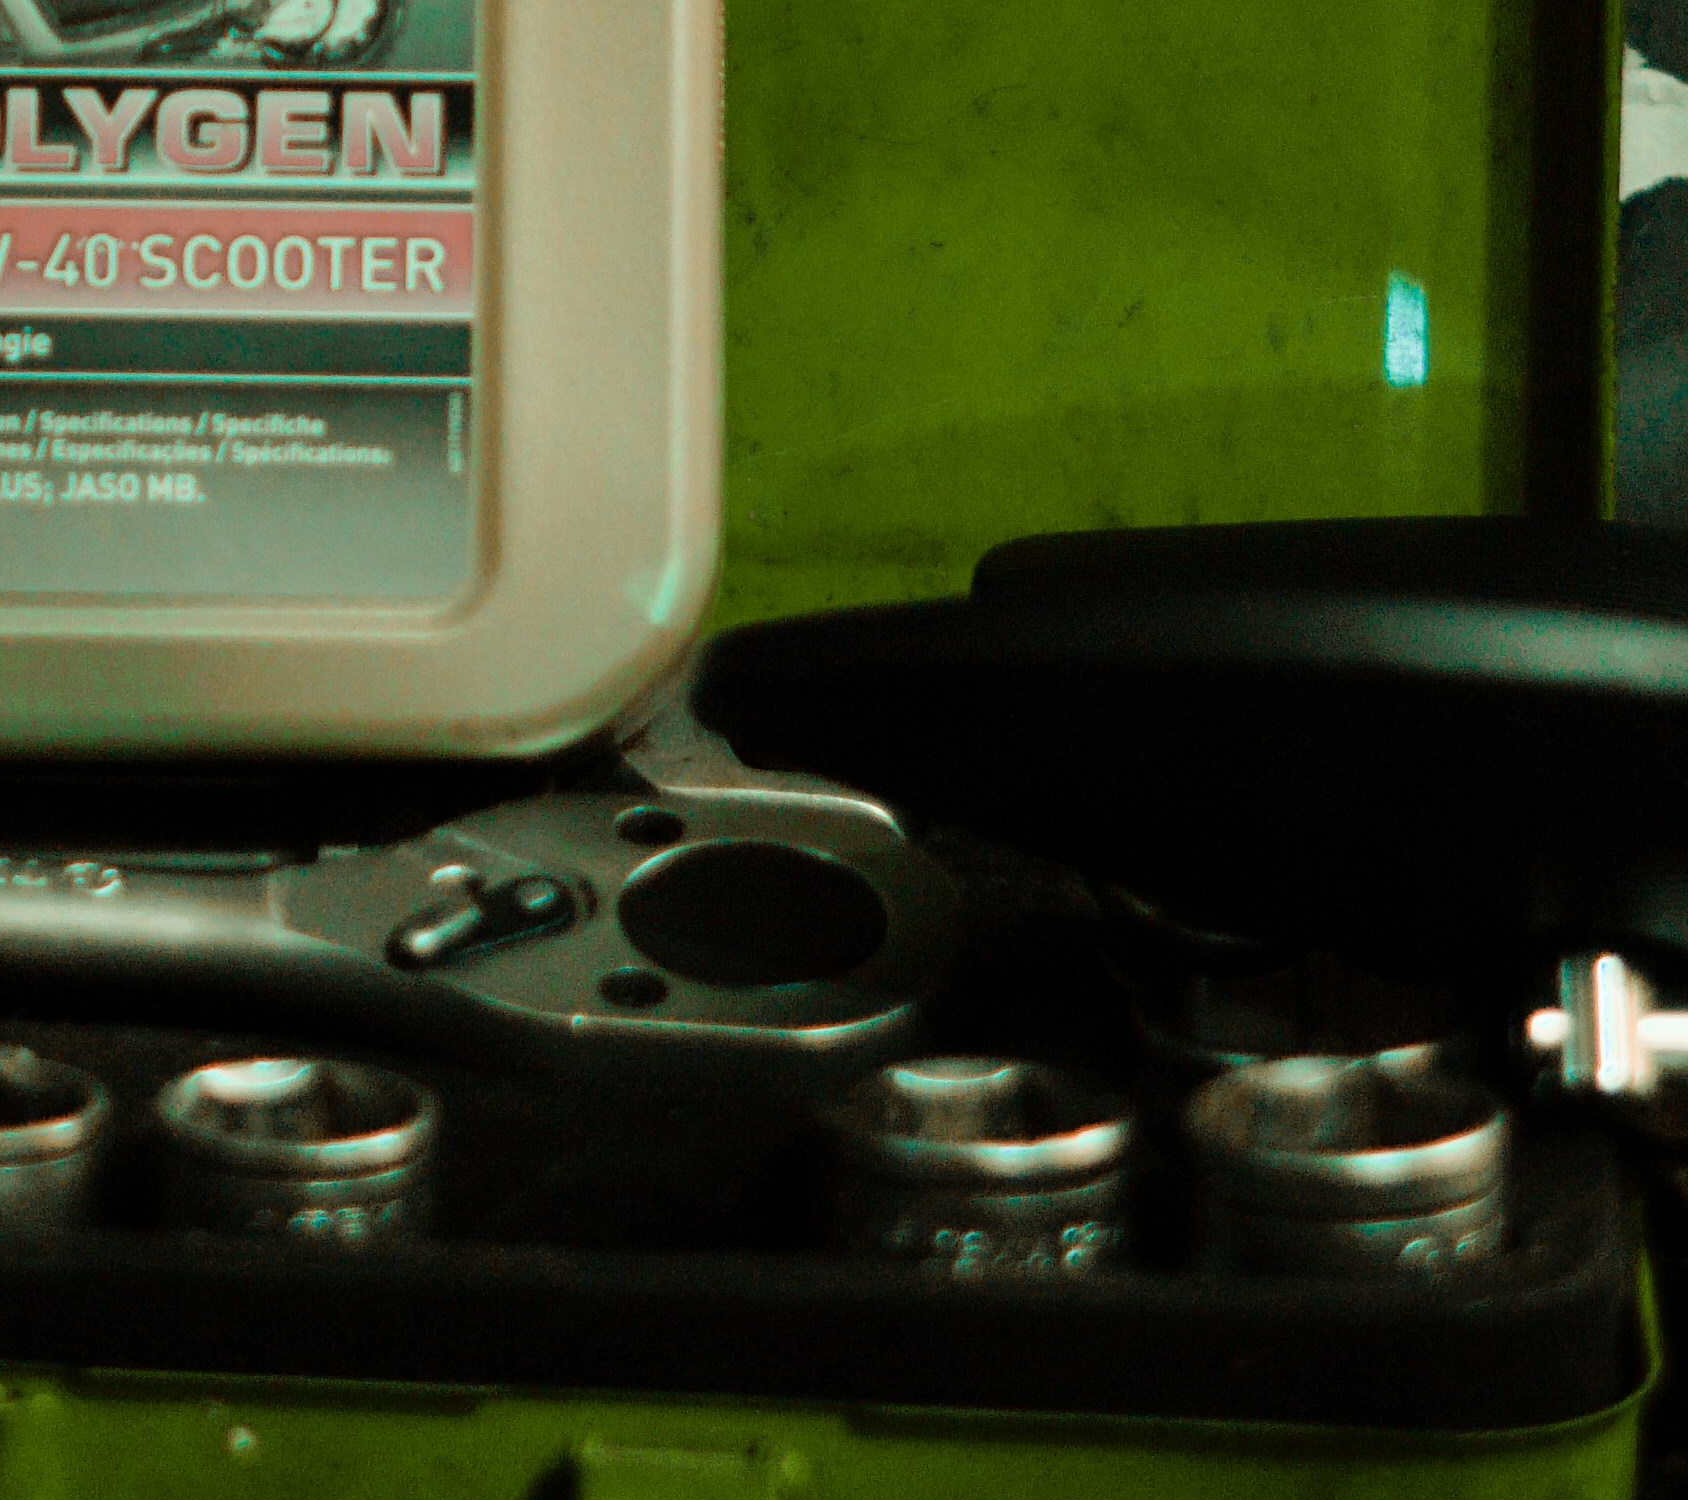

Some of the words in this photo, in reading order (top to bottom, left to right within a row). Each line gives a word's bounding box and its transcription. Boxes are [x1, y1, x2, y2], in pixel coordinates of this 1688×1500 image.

[138, 234, 446, 292] SCOOTER
[24, 408, 38, 433] /
[40, 410, 193, 437] Specifications
[195, 411, 210, 436] /
[35, 438, 49, 462] /
[215, 440, 228, 464] /
[63, 472, 140, 501] JASO
[147, 473, 207, 504] MB.
